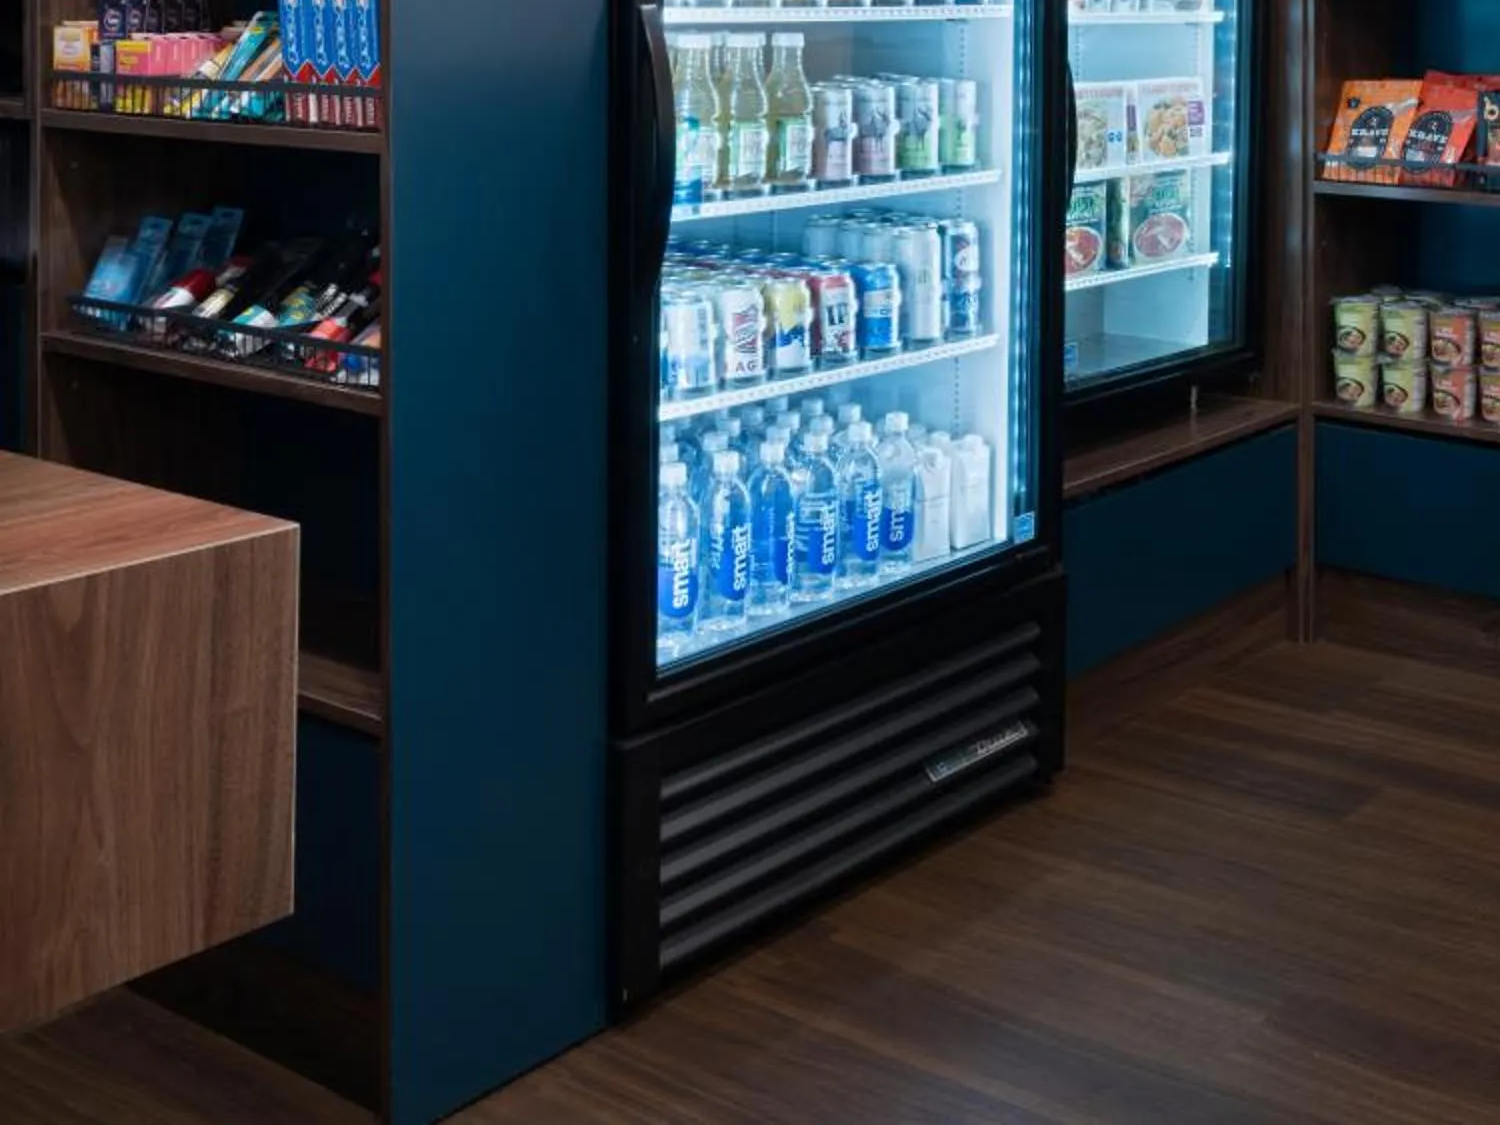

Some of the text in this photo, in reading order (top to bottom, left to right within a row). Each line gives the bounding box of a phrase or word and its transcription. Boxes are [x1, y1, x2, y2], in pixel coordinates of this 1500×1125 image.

[1408, 129, 1448, 145] KRAVE
[820, 502, 836, 566] smart
[863, 489, 880, 553] smart
[670, 538, 690, 609] smart
[731, 524, 749, 592] smart
